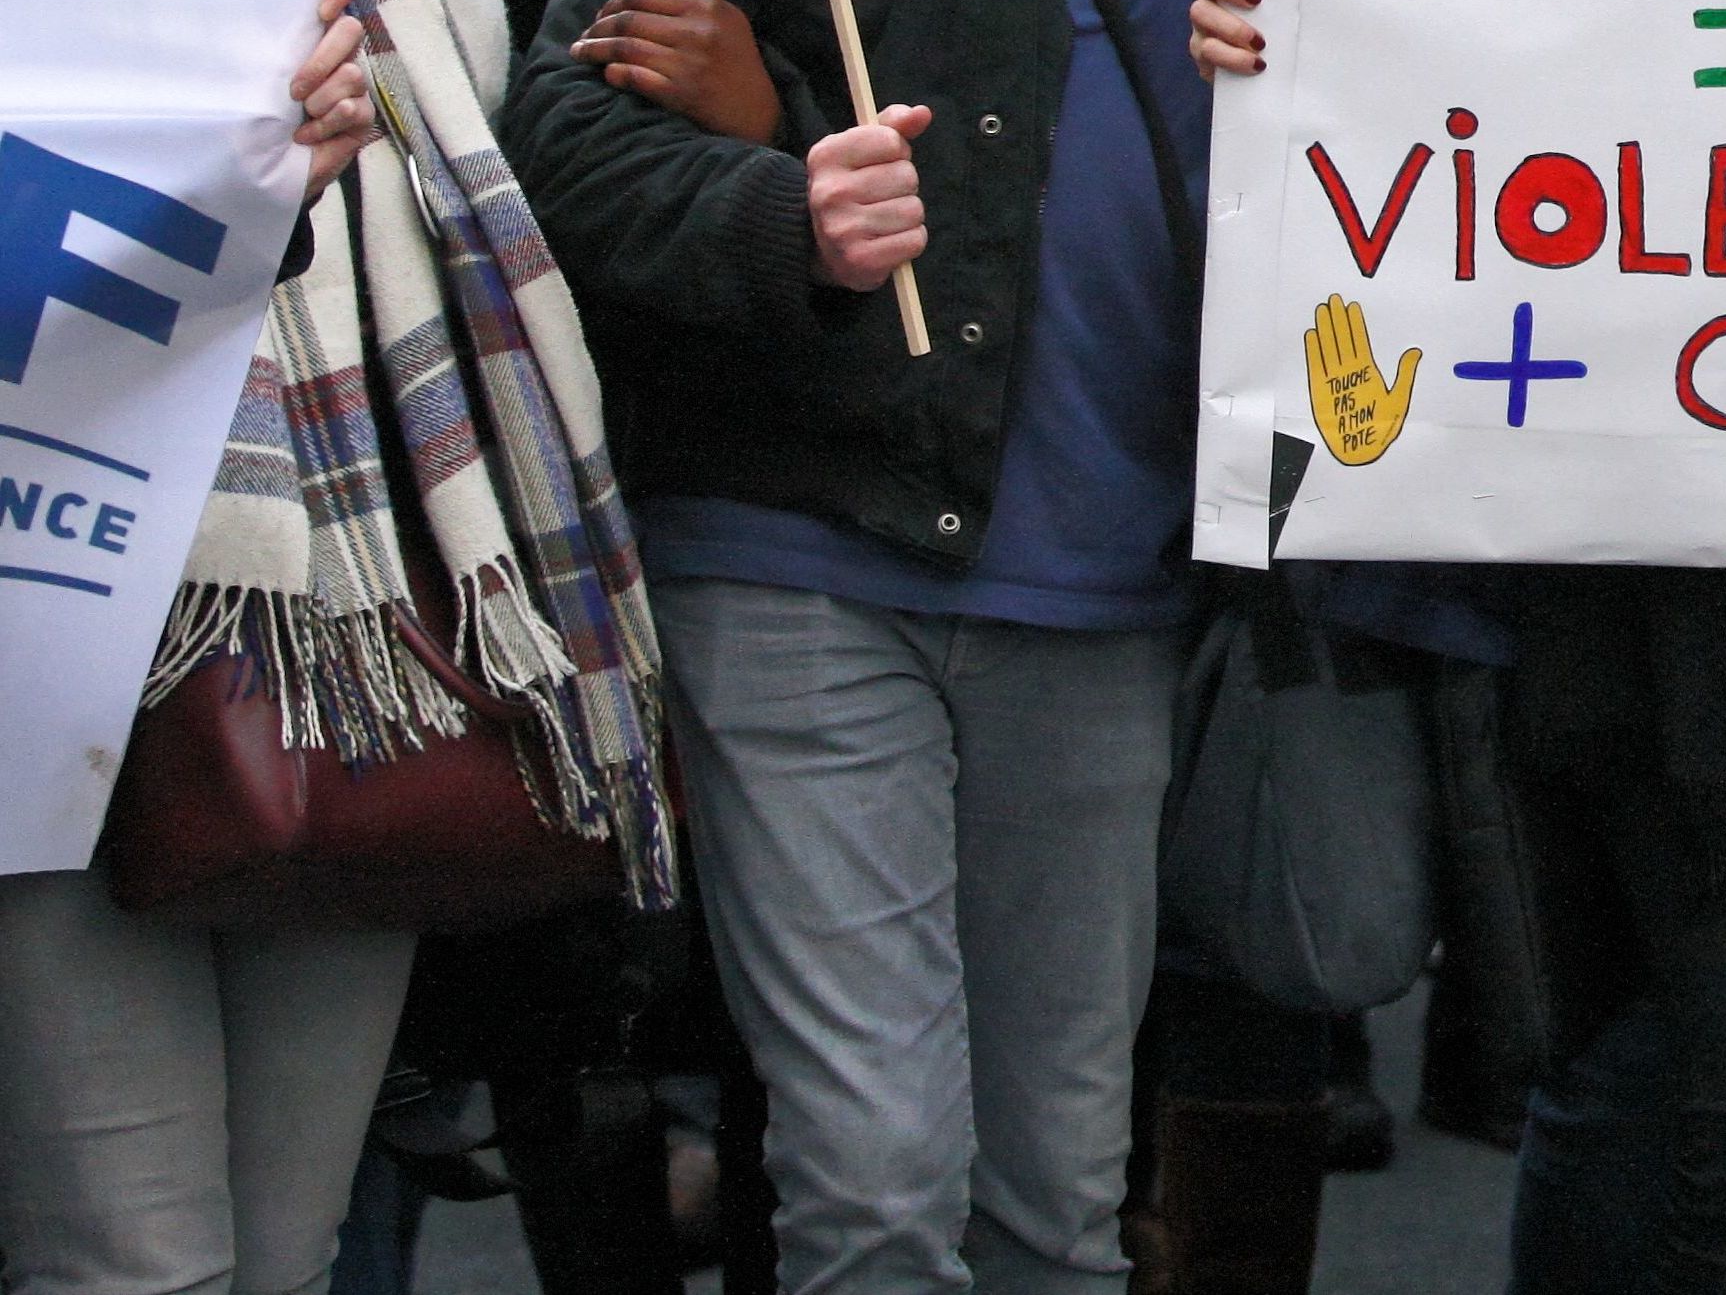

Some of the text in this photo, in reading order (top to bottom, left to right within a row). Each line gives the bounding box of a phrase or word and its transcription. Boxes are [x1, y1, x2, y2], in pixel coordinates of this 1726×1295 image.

[1326, 365, 1371, 395] TOUCHE
[1333, 392, 1355, 416] PAS
[1343, 426, 1377, 453] POTE
